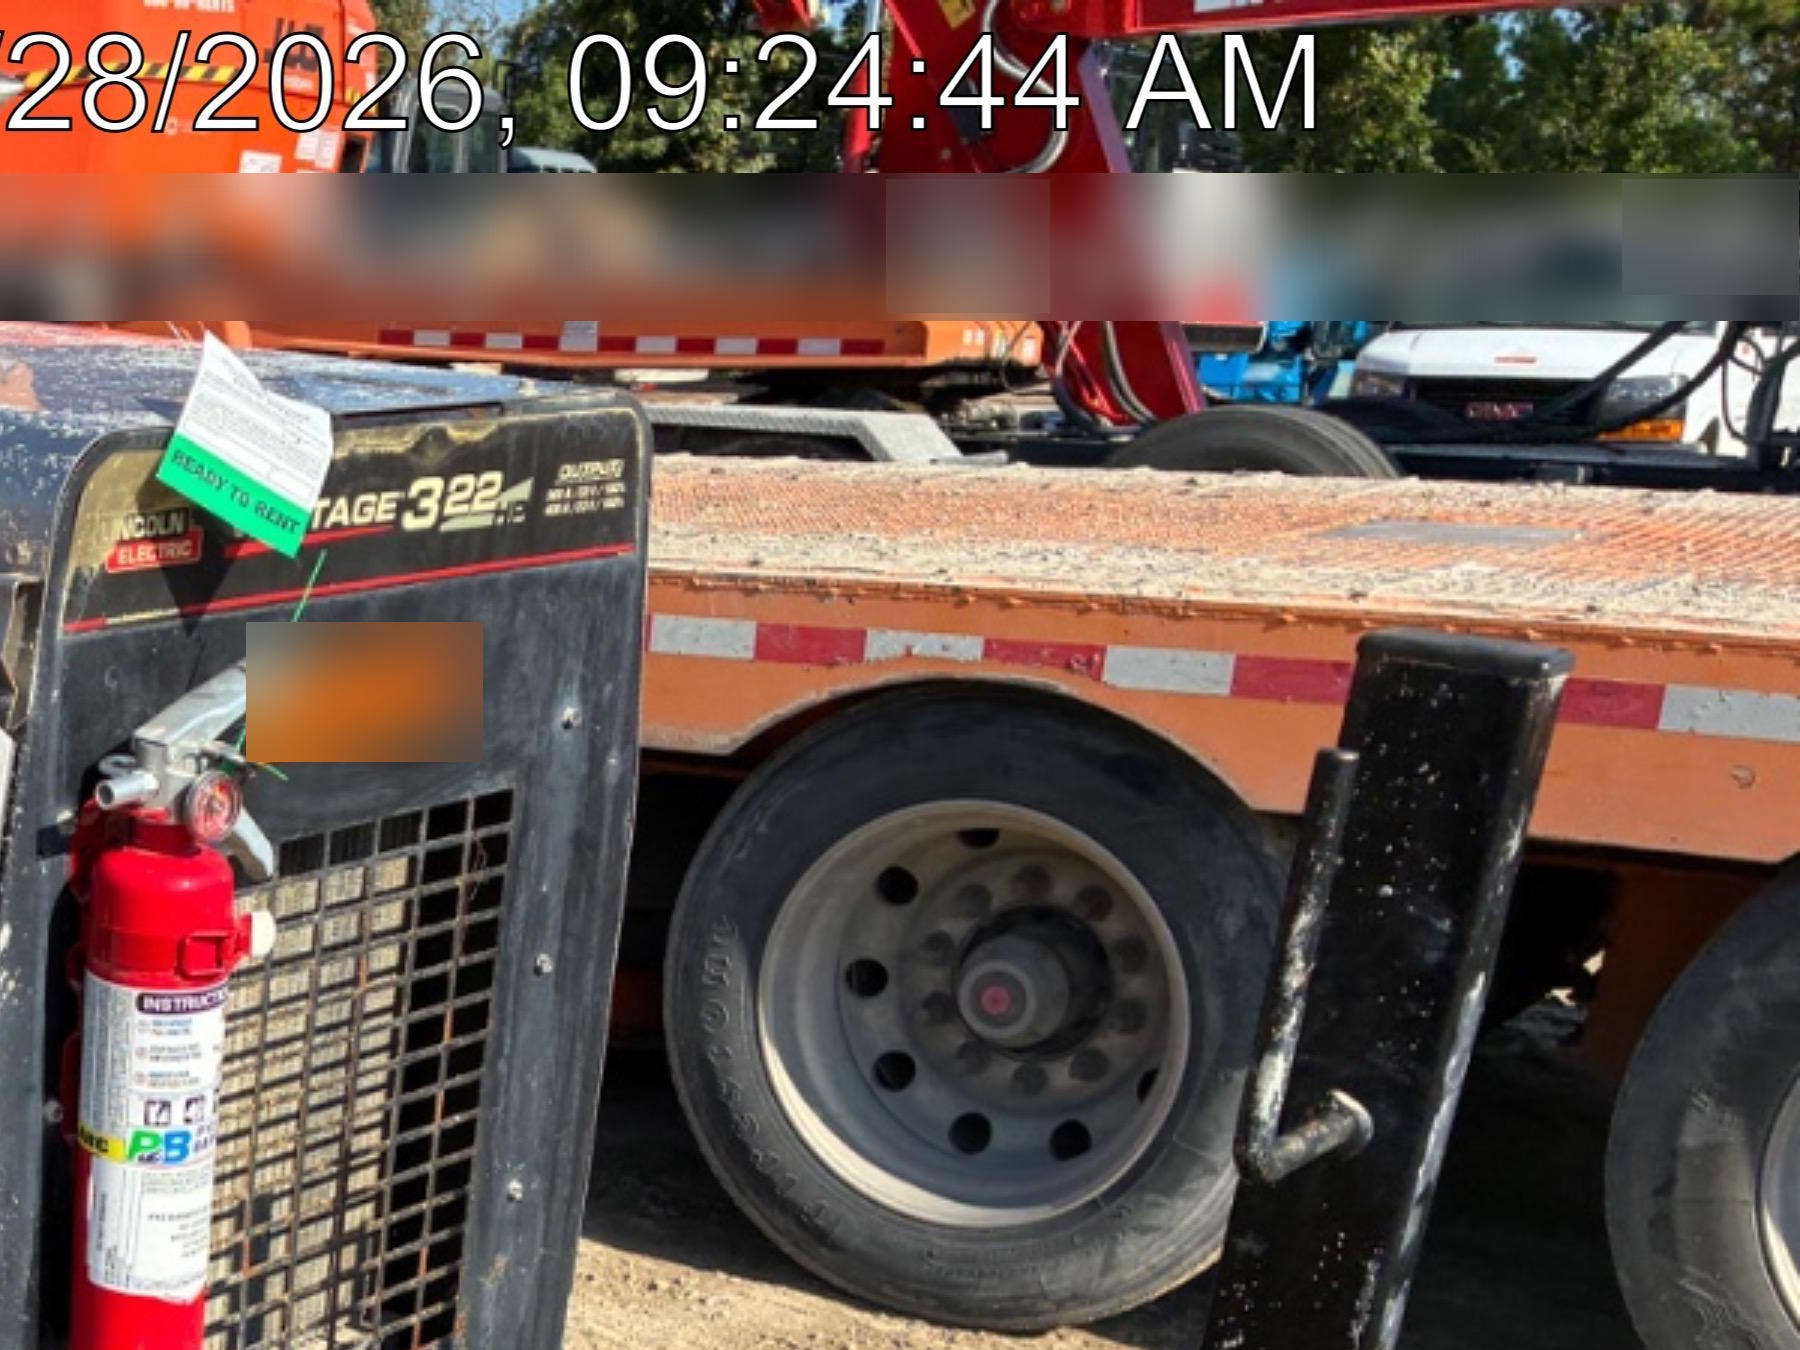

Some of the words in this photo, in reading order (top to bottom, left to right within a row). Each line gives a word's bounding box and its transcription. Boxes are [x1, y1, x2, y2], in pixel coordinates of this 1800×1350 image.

[171, 450, 229, 491] READY
[230, 481, 251, 508] TO
[254, 500, 302, 534] RENT
[401, 470, 504, 533] 322
[117, 540, 193, 566] ELECTRIC
